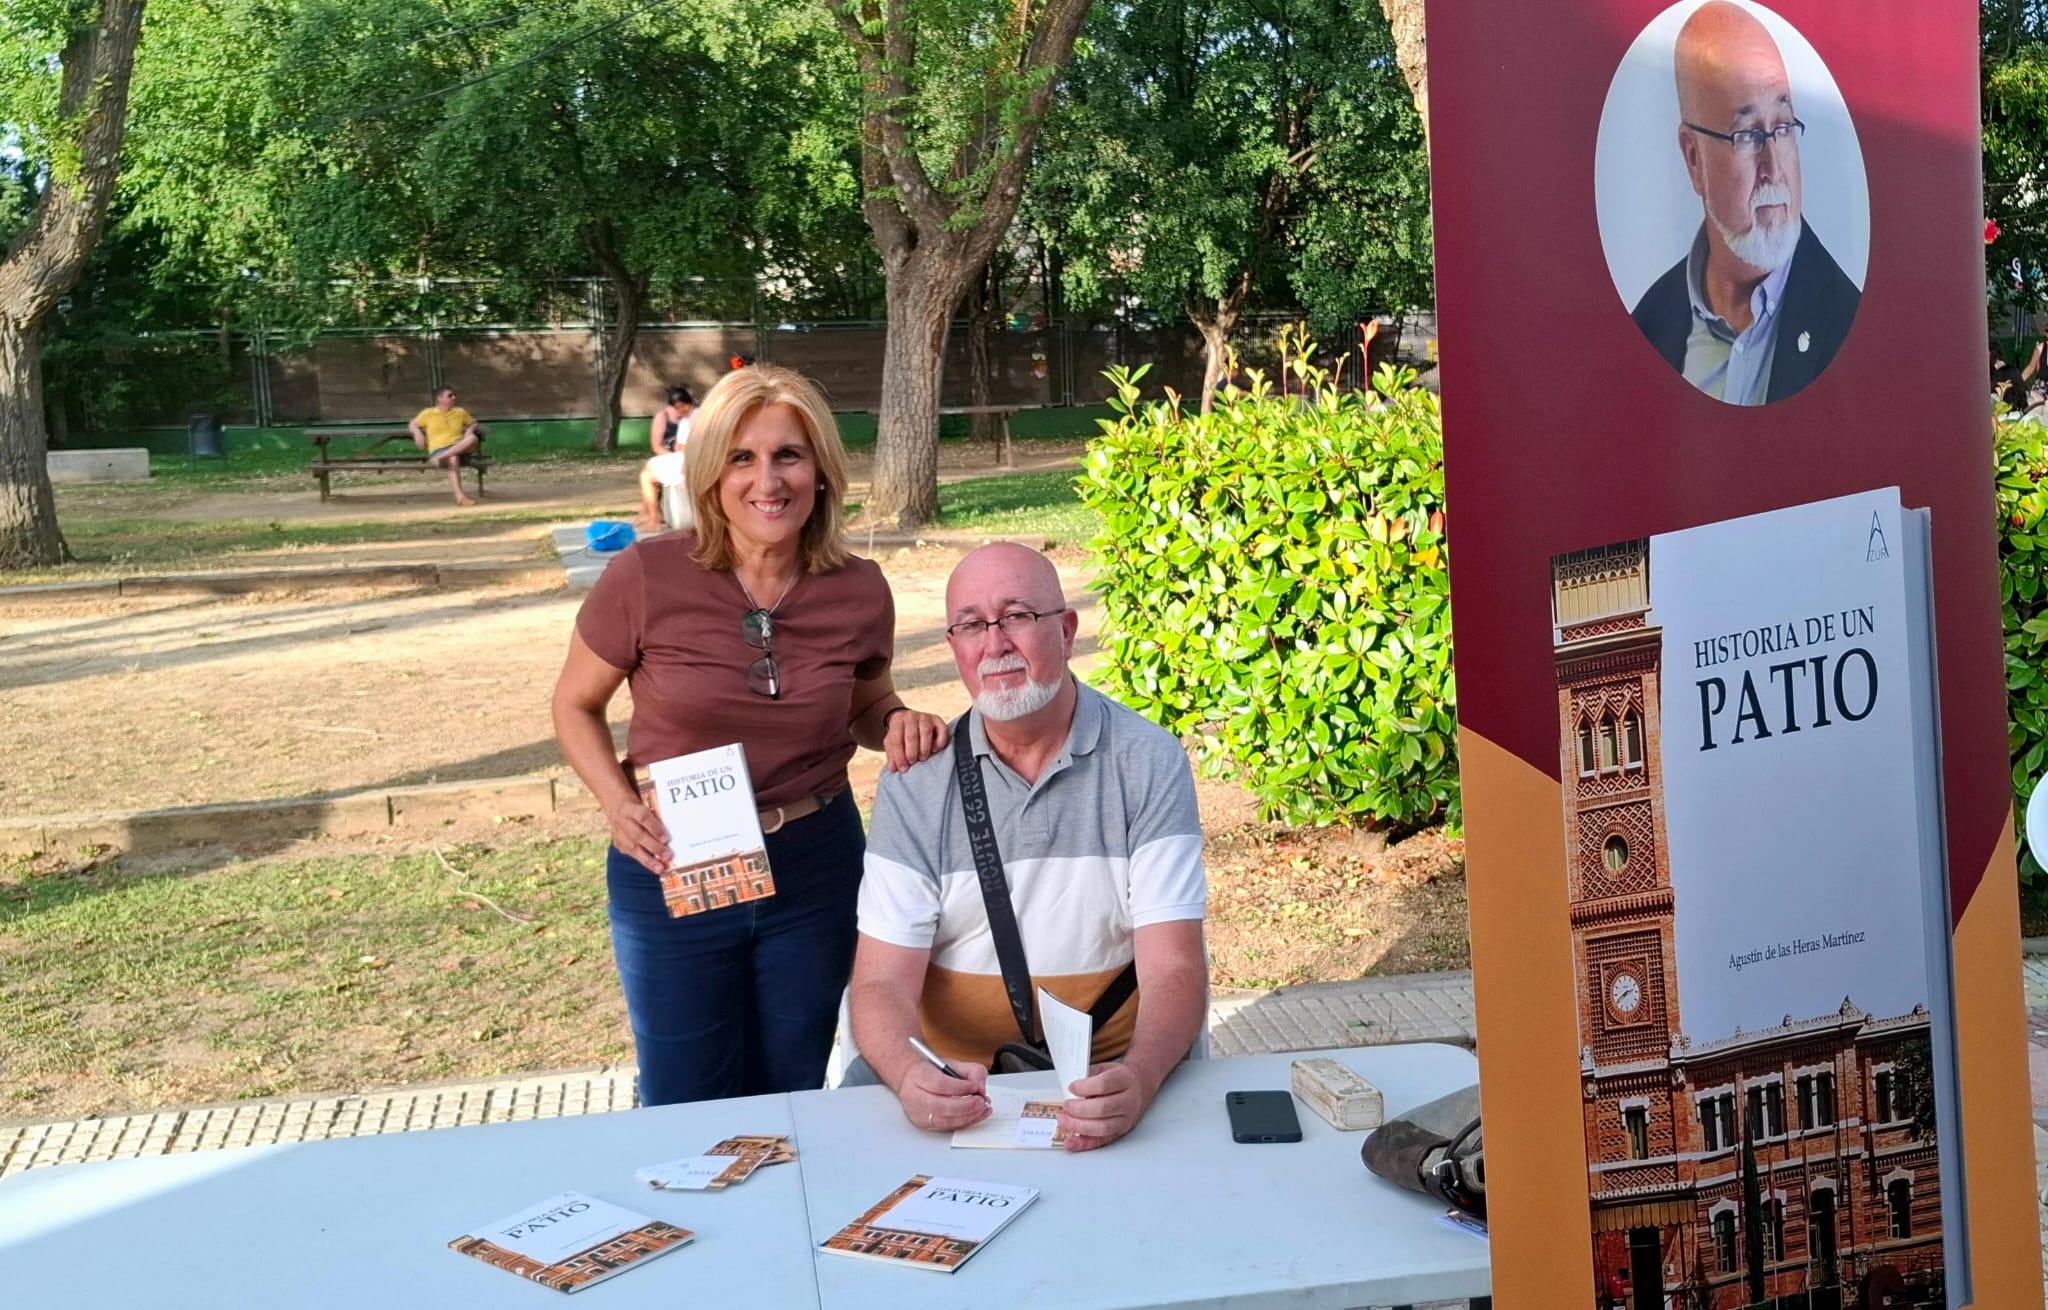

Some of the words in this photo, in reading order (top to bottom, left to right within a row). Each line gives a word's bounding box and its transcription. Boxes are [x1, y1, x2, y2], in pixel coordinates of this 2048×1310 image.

[1694, 622, 1799, 669] HISTORIA
[1804, 614, 1836, 646] DE
[1841, 606, 1875, 638] UN
[1696, 647, 1879, 752] PATIO
[669, 774, 736, 804] PATIO
[1728, 949, 1763, 971] Agustín
[1765, 945, 1777, 961] de
[1778, 943, 1791, 958] las
[1793, 938, 1821, 955] Heras
[1822, 930, 1866, 950] Martínez
[925, 1190, 1010, 1208] PATIO
[507, 1202, 591, 1239] PATIO
